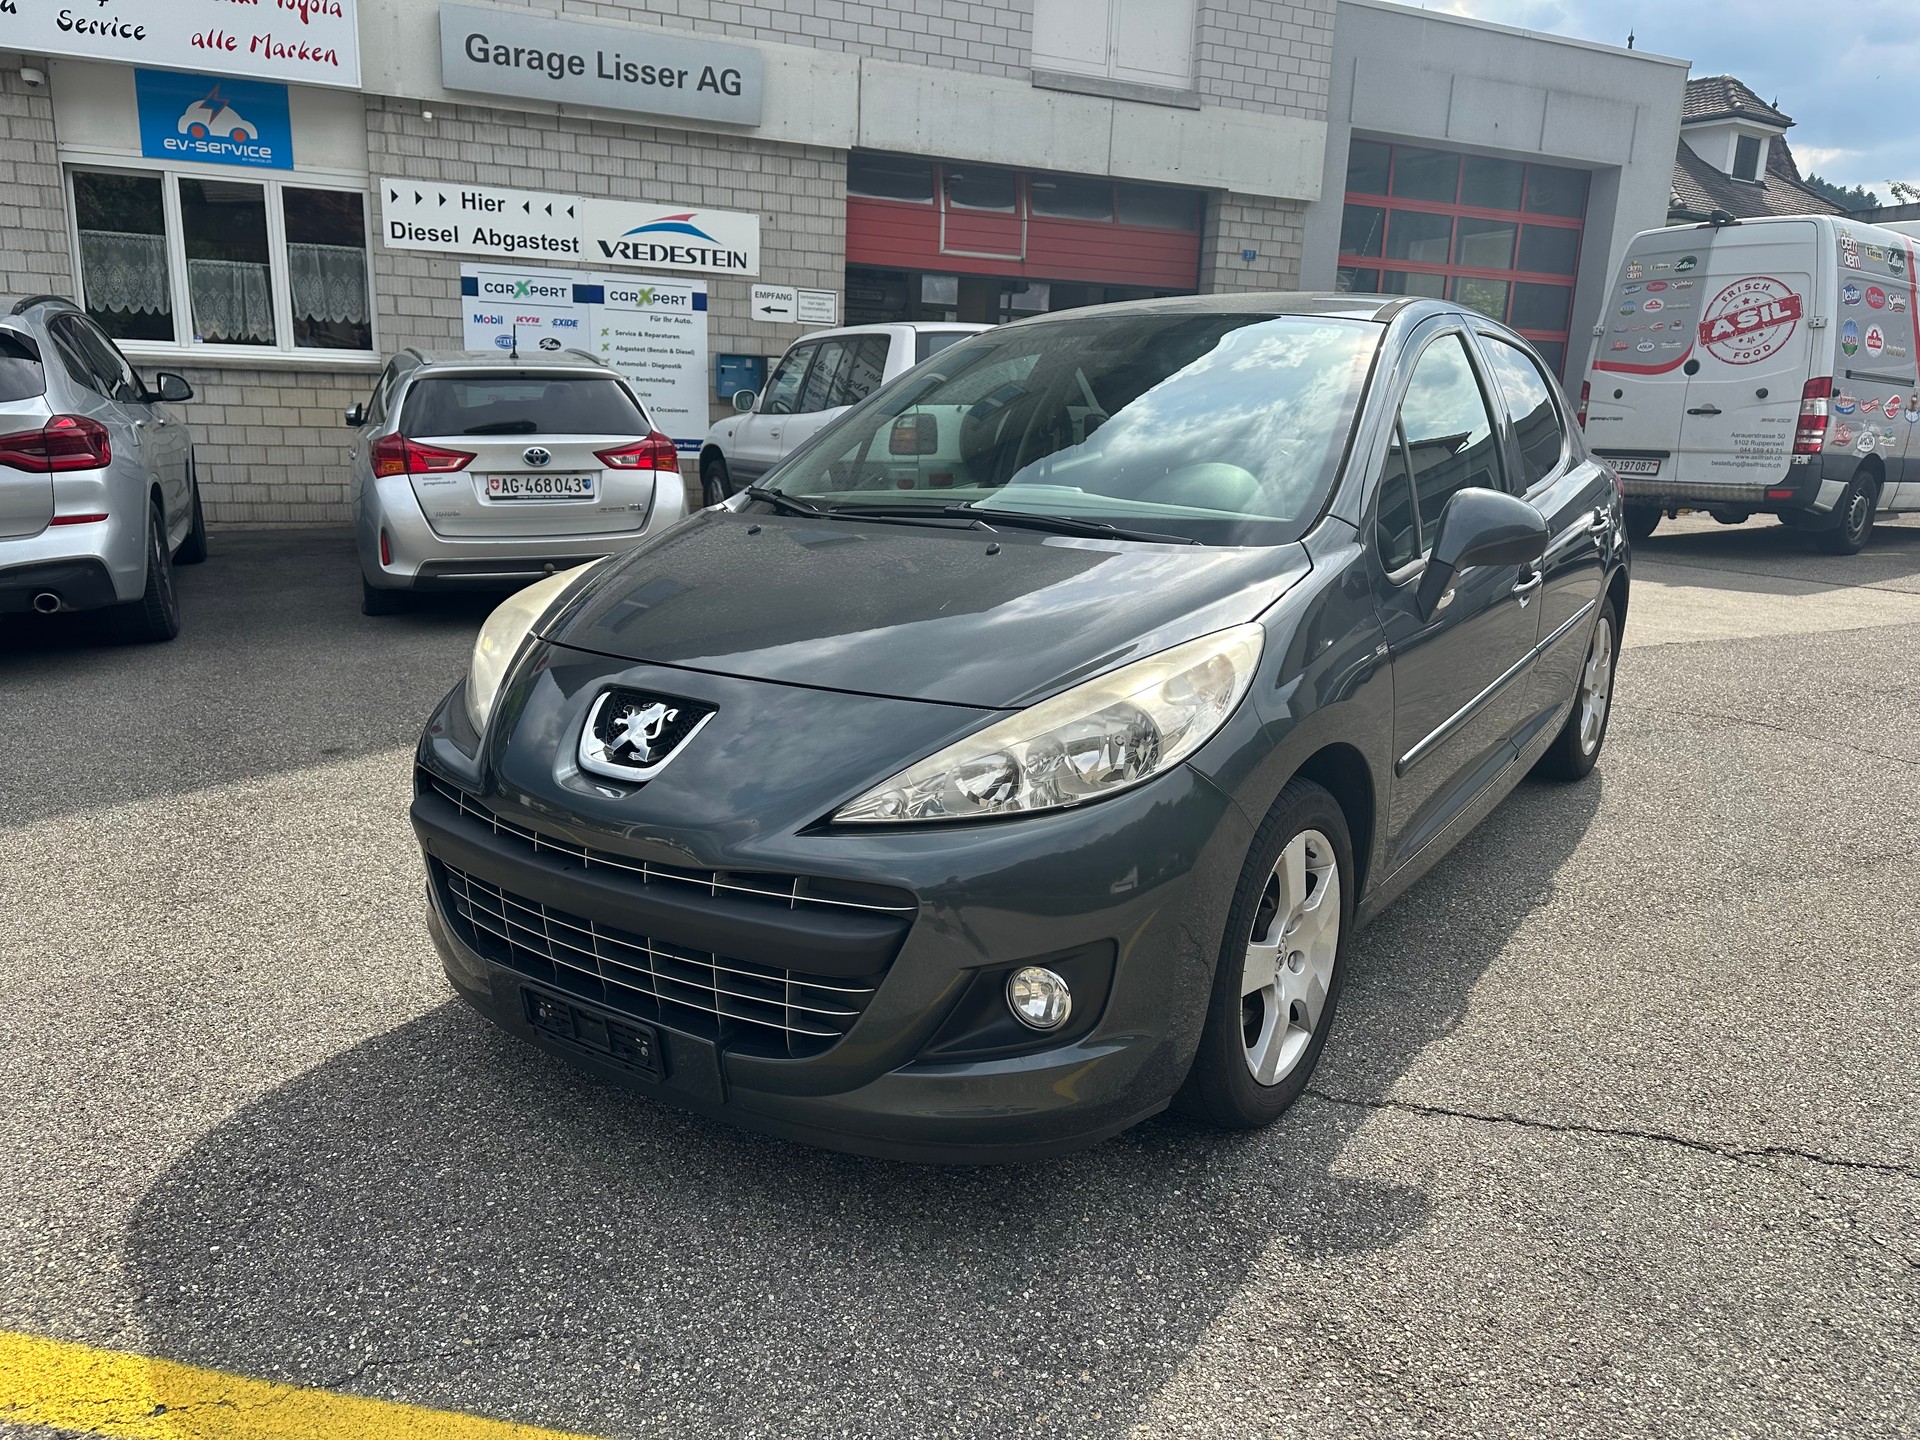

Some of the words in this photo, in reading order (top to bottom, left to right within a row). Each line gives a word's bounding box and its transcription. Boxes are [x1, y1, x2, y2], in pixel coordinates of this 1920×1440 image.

[56, 9, 147, 41] Service
[191, 29, 238, 52] alle
[249, 33, 339, 67] Marken
[464, 33, 586, 80] Garage
[596, 50, 689, 88] Lisser
[696, 65, 742, 96] AG
[163, 138, 272, 158] ev-service
[460, 191, 506, 213] Hier
[390, 221, 460, 243] Diesel
[472, 226, 580, 253] Abgastest
[596, 239, 748, 269] VREDESTEIN
[754, 290, 793, 301] EMPFANG
[1721, 283, 1771, 302] FRISCH
[473, 313, 504, 325] Mobil
[551, 318, 579, 328] EXIDE
[663, 315, 673, 323] Ihr
[674, 317, 693, 325] Auto.
[1711, 302, 1792, 338] ASIL
[615, 329, 637, 337] Service
[644, 331, 680, 340] Reparaturen
[615, 345, 646, 353] Abgastest
[675, 348, 696, 356] Diesel)
[1733, 344, 1771, 359] FOOD
[616, 360, 647, 368] Automobil
[651, 361, 682, 370] Diagnostik
[635, 375, 676, 385] Bereitstellung
